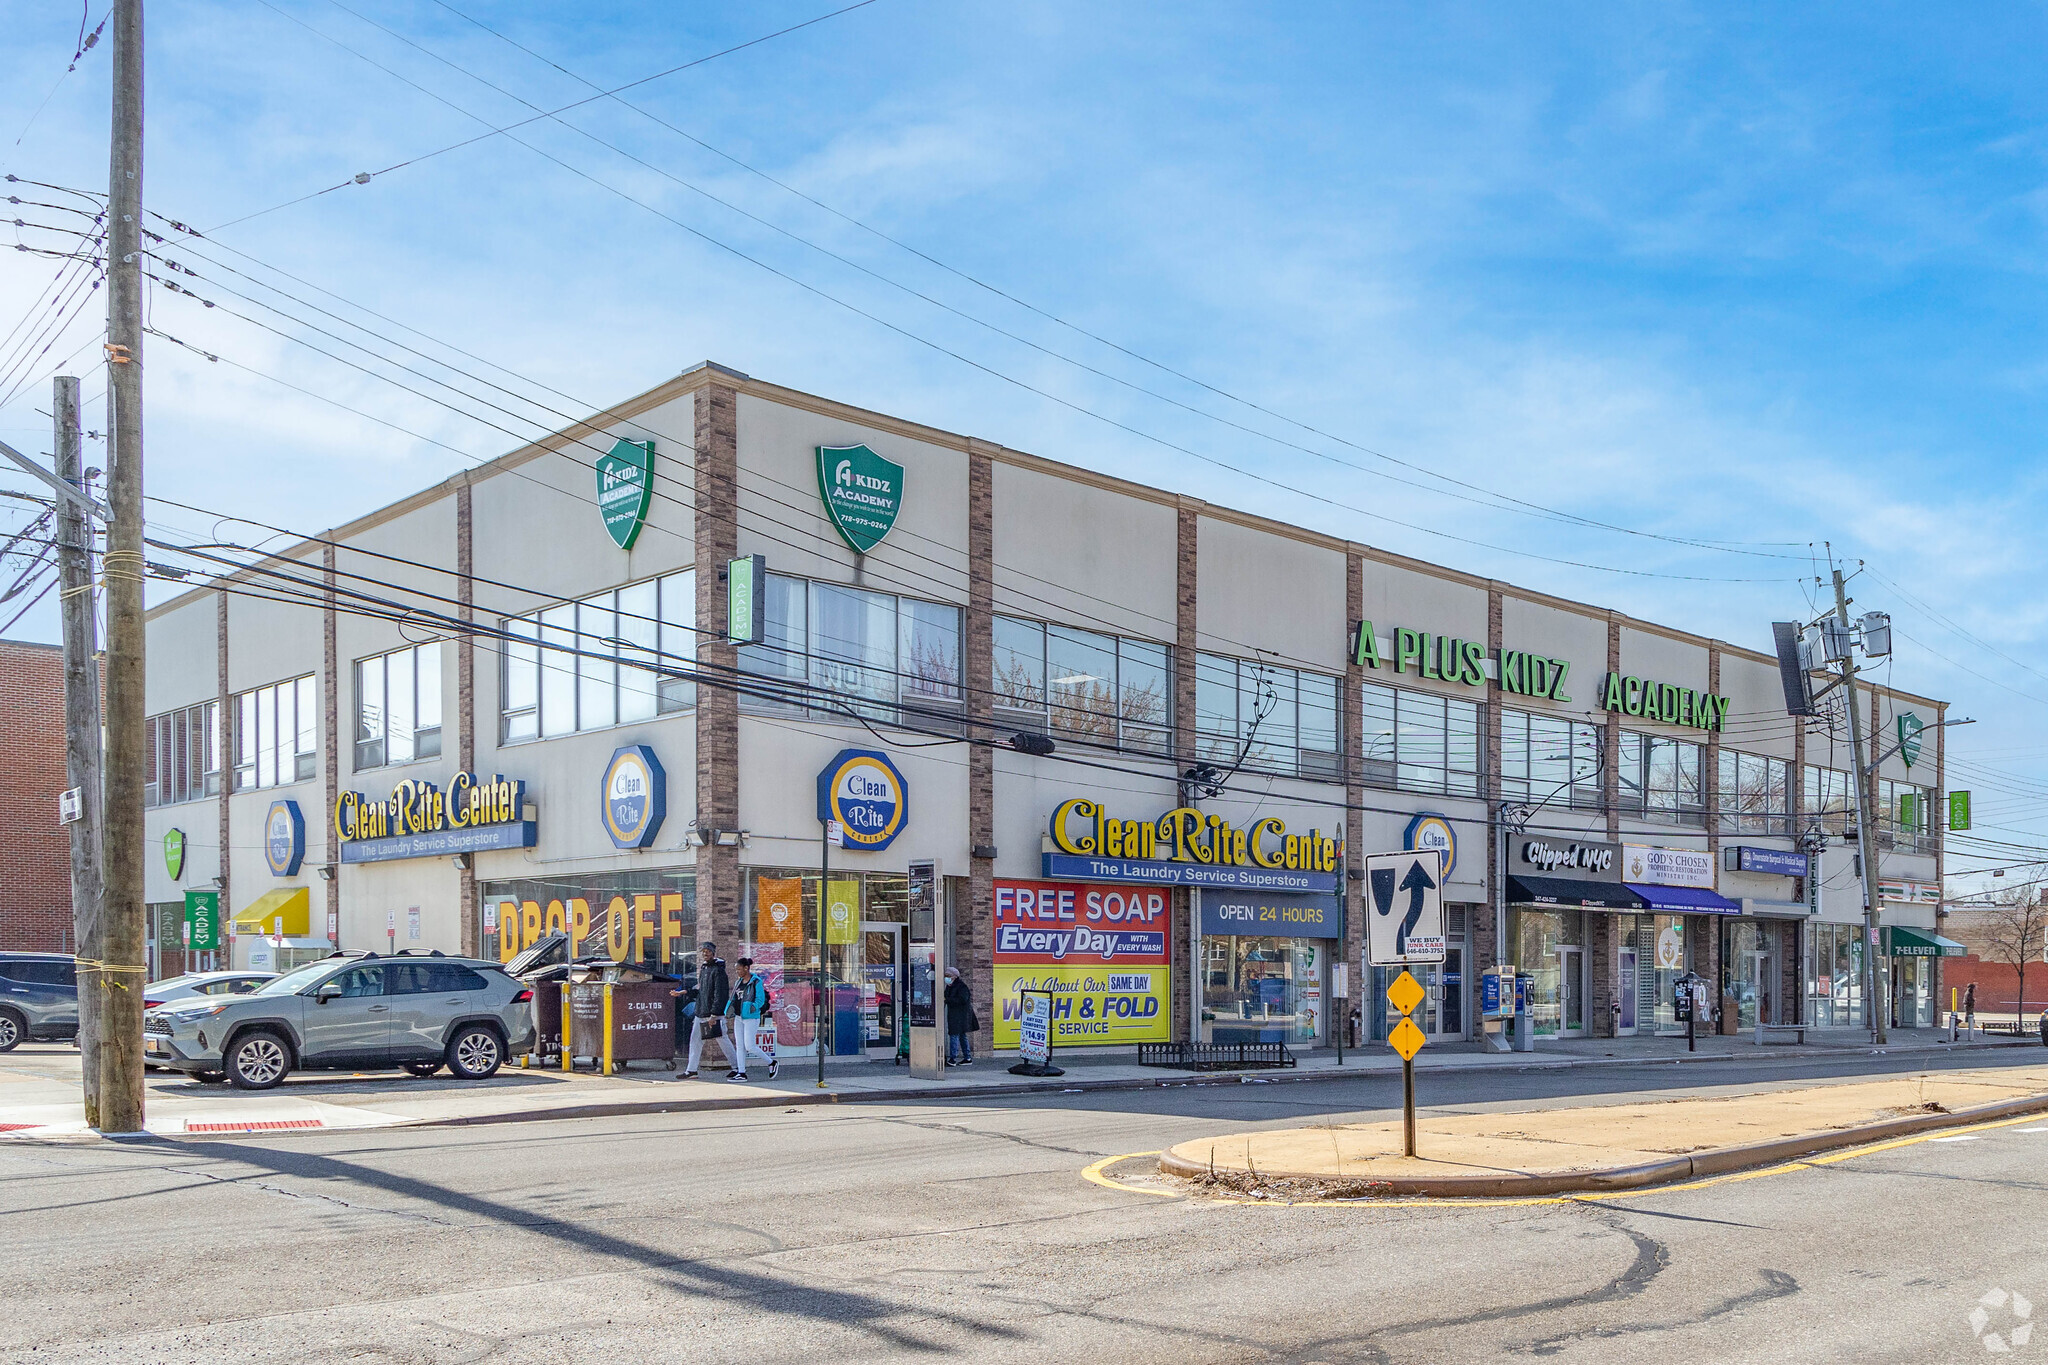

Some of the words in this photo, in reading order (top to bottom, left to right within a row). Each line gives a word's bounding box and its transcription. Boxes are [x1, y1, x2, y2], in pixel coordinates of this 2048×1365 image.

[616, 466, 638, 484] KIDZ
[856, 474, 891, 493] KIDZ
[602, 484, 640, 505] ACADEMY
[833, 486, 893, 508] ACADEMY
[840, 514, 888, 530] 718-975-0266
[736, 583, 747, 638] ACADEMY
[1352, 620, 1381, 669] A
[1394, 627, 1487, 686] PLUS
[1500, 648, 1572, 702] KIDZ
[1602, 672, 1731, 733] ACADEMY
[616, 774, 640, 794] Clean
[848, 775, 886, 797] Clean
[335, 790, 388, 842] Clean
[390, 779, 443, 835] Rite
[446, 770, 520, 828] Center
[616, 802, 638, 825] Rite
[848, 806, 884, 827] Rite
[1051, 798, 1156, 858] Clean
[1156, 808, 1246, 865] Rite
[1424, 831, 1446, 846] Clean
[362, 845, 376, 857] The
[378, 842, 411, 856] Laundry
[413, 836, 446, 851] Service
[448, 832, 500, 848] Superstore
[1528, 842, 1580, 871] Clipped
[1582, 848, 1612, 872] NYC
[1647, 852, 1673, 865] GOD'S
[1675, 856, 1708, 868] CHOSEN
[1090, 862, 1118, 876] The
[1123, 864, 1181, 882] Laundry
[1185, 868, 1236, 884] Service
[1239, 872, 1309, 888] Superstore
[1648, 864, 1674, 872] PROPHETIC
[1675, 867, 1708, 875] RESTORATION
[1656, 872, 1685, 880] MINISTRY
[996, 888, 1075, 920] FREE
[1086, 892, 1164, 922] SOAP
[1220, 904, 1254, 920] OPEN
[1259, 906, 1276, 922] 24
[1282, 907, 1324, 923] HOURS
[195, 905, 209, 944] ACADEMY
[606, 893, 683, 964] OFF
[1000, 925, 1072, 956] Every
[1074, 926, 1119, 957] Day
[1012, 977, 1037, 992] Ask
[1042, 977, 1080, 992] About
[1083, 977, 1106, 992] Our
[1111, 976, 1133, 990] SAME
[1134, 976, 1148, 990] DAY
[1002, 997, 1072, 1022] WH
[1079, 997, 1095, 1018] &
[1102, 996, 1159, 1019] FOLD
[622, 1022, 668, 1031] Lic#-1431
[1023, 1021, 1046, 1030] COMFORTER
[1058, 1022, 1109, 1034] SERVICE
[541, 1034, 546, 1042] 2
[756, 1034, 774, 1044] TM
[1026, 1031, 1045, 1041] $14.99
